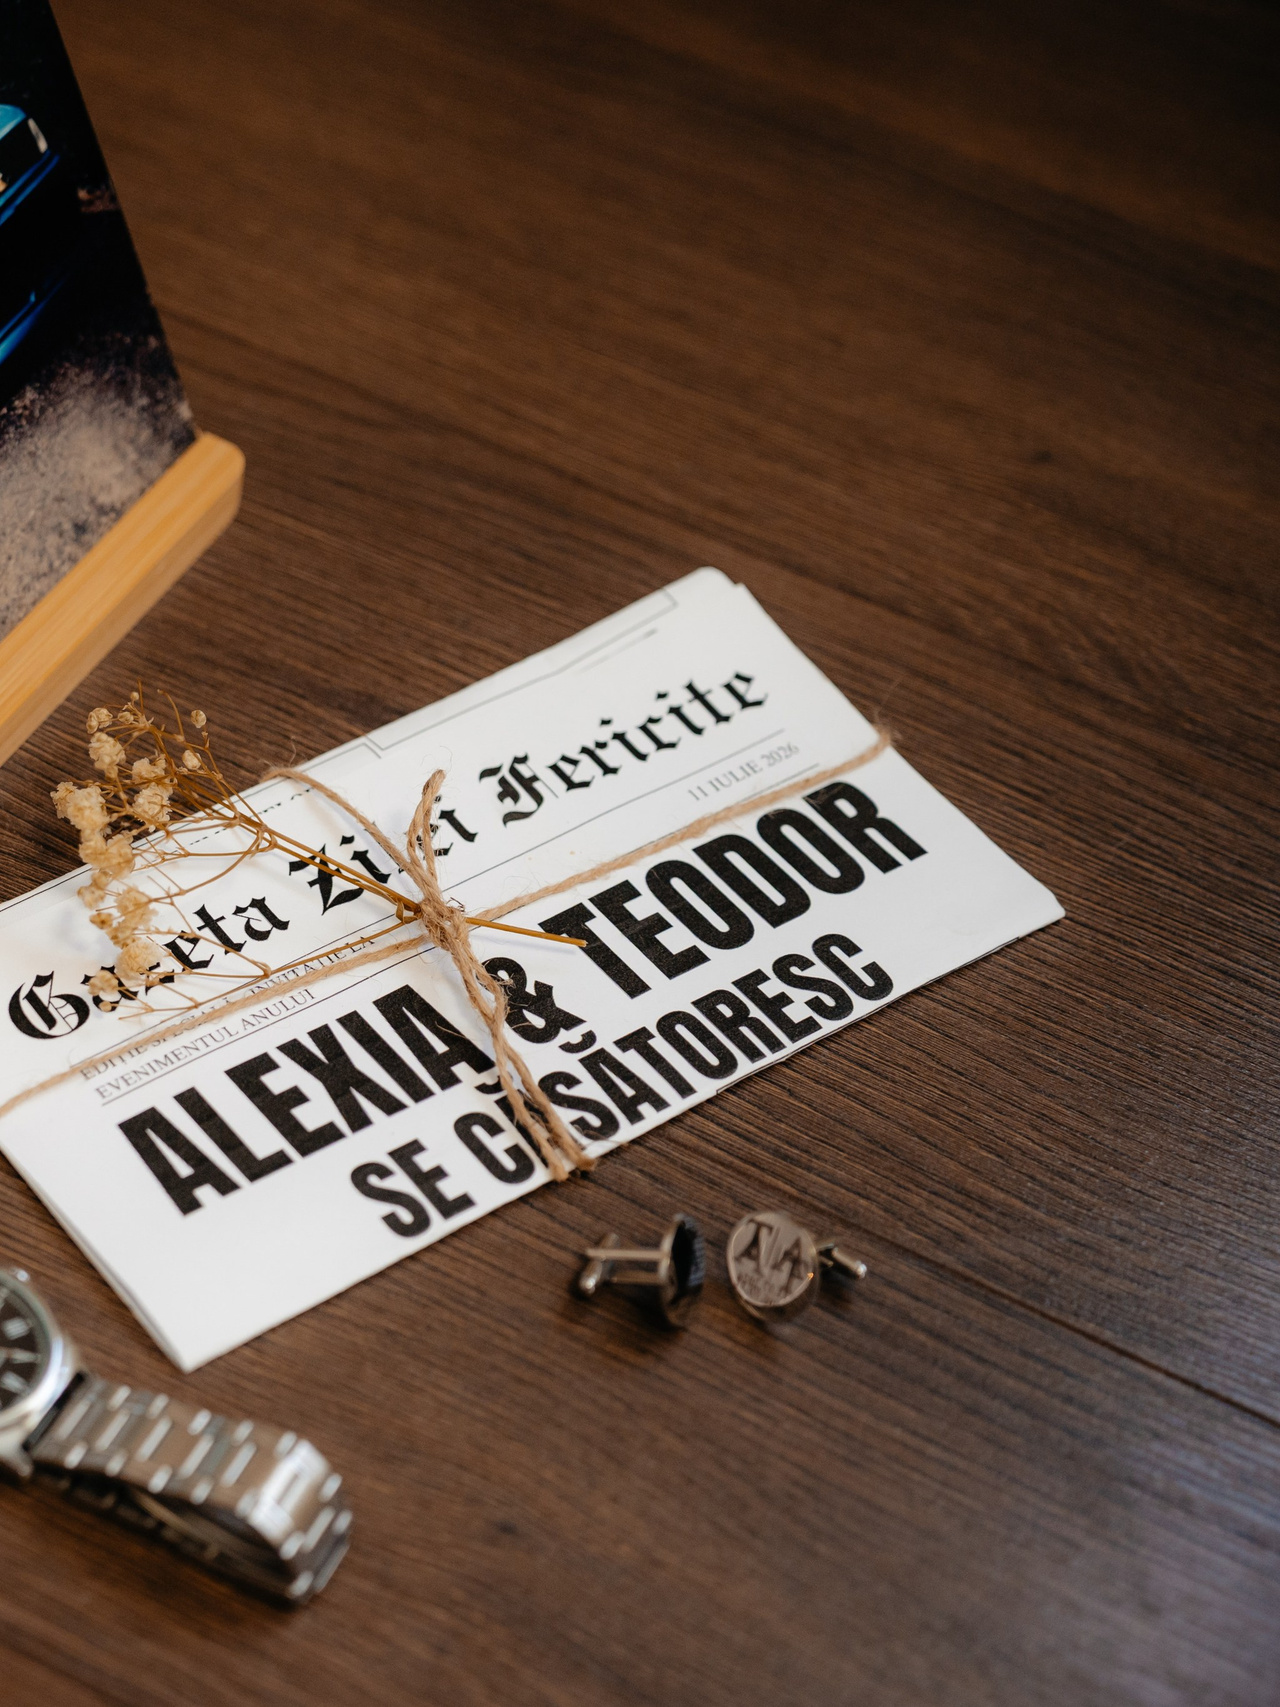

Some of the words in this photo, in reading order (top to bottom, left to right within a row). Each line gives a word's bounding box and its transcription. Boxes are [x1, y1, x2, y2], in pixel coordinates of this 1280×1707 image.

[288, 794, 479, 916] Zii
[478, 671, 768, 827] Fericite
[687, 785, 709, 801] 11
[708, 760, 763, 792] IULIE
[760, 742, 800, 767] 2026
[95, 1026, 239, 1099] EVENIMENTUL
[240, 988, 315, 1031] ANULUI
[118, 984, 497, 1216] ALEXIA
[476, 957, 587, 1043] &
[537, 780, 928, 1000] TEODOR
[351, 1138, 477, 1238] SE
